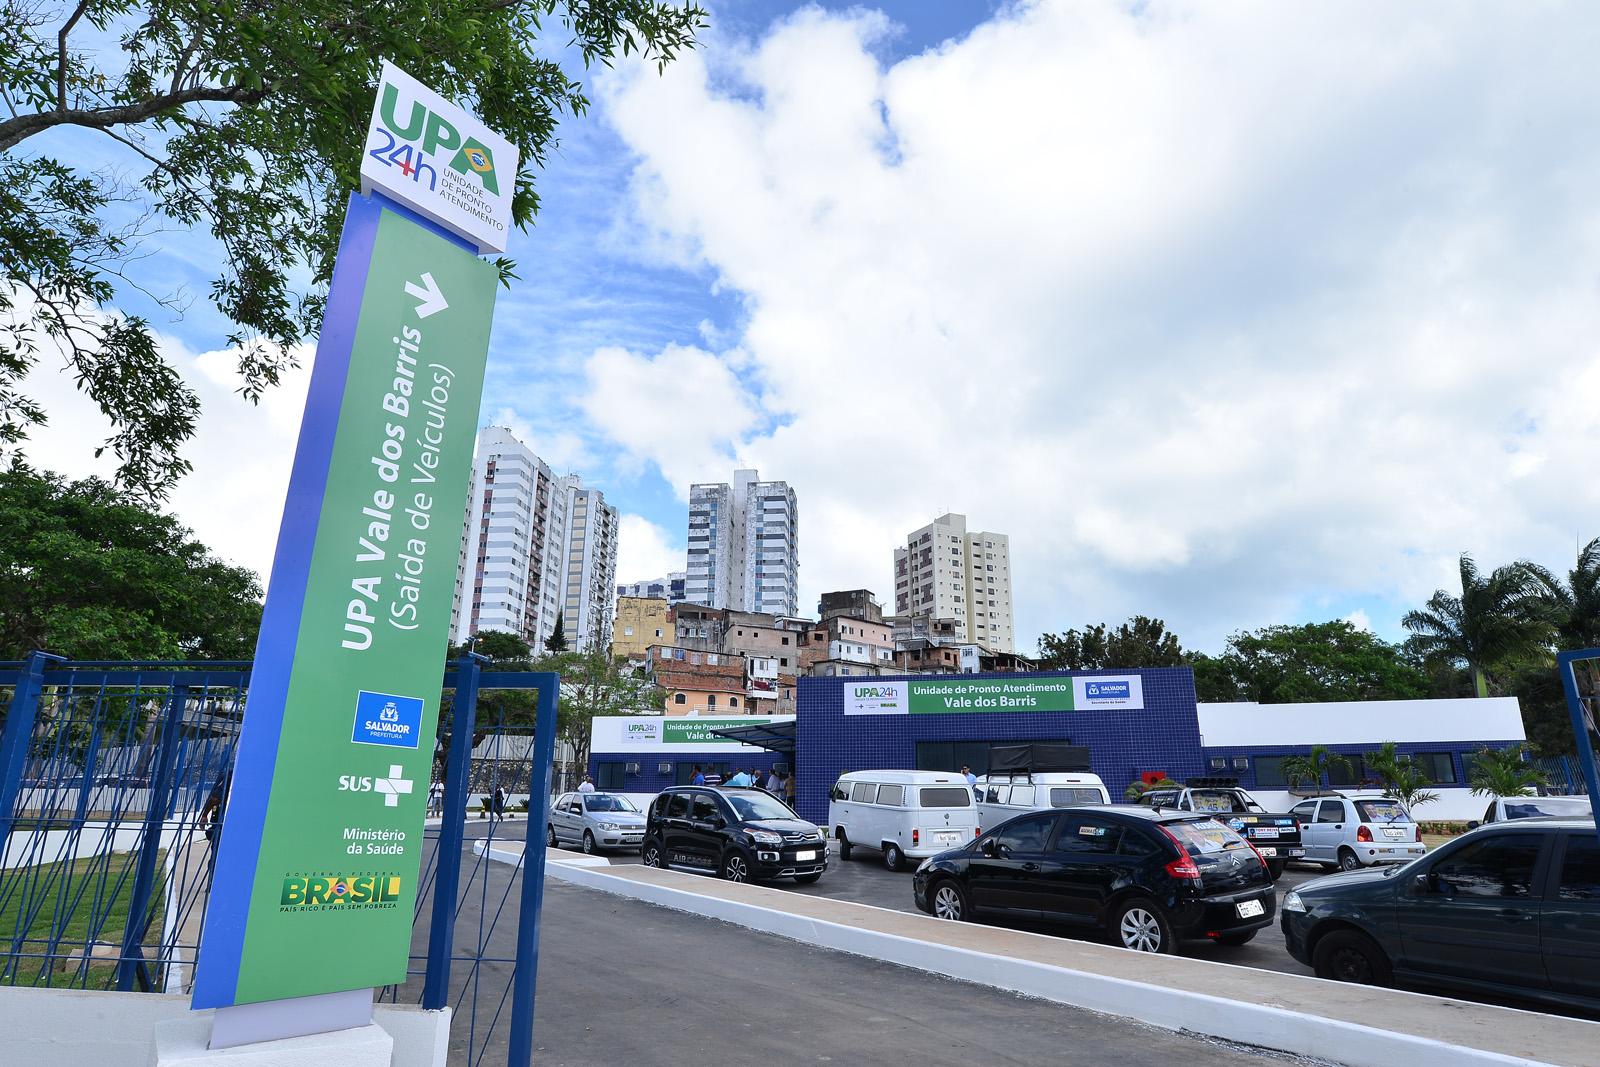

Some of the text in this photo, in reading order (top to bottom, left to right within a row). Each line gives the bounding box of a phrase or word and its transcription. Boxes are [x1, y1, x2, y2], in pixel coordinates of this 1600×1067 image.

[380, 81, 500, 197] UPA
[369, 127, 437, 192] 24h
[443, 168, 484, 198] UNIDADE
[441, 178, 492, 214] DE PRONTO
[439, 189, 504, 231] ATENDIMENTO
[341, 325, 422, 651] UPA Vale dos Barris
[388, 363, 456, 630] (Saída de Veículos)
[913, 683, 1067, 695] Unidade de Pronto Atendimento
[943, 695, 1037, 708] Vale dos Barris
[365, 720, 410, 735] SALVADOR
[369, 730, 403, 740] PREFEITURA
[686, 731, 704, 740] Vale
[338, 775, 372, 792] SUS
[343, 827, 406, 841] Ministério
[346, 841, 404, 855] da Saúde
[280, 877, 401, 905] BRASIL
[279, 905, 297, 913] PAÍS
[328, 903, 345, 911] PAÍS
